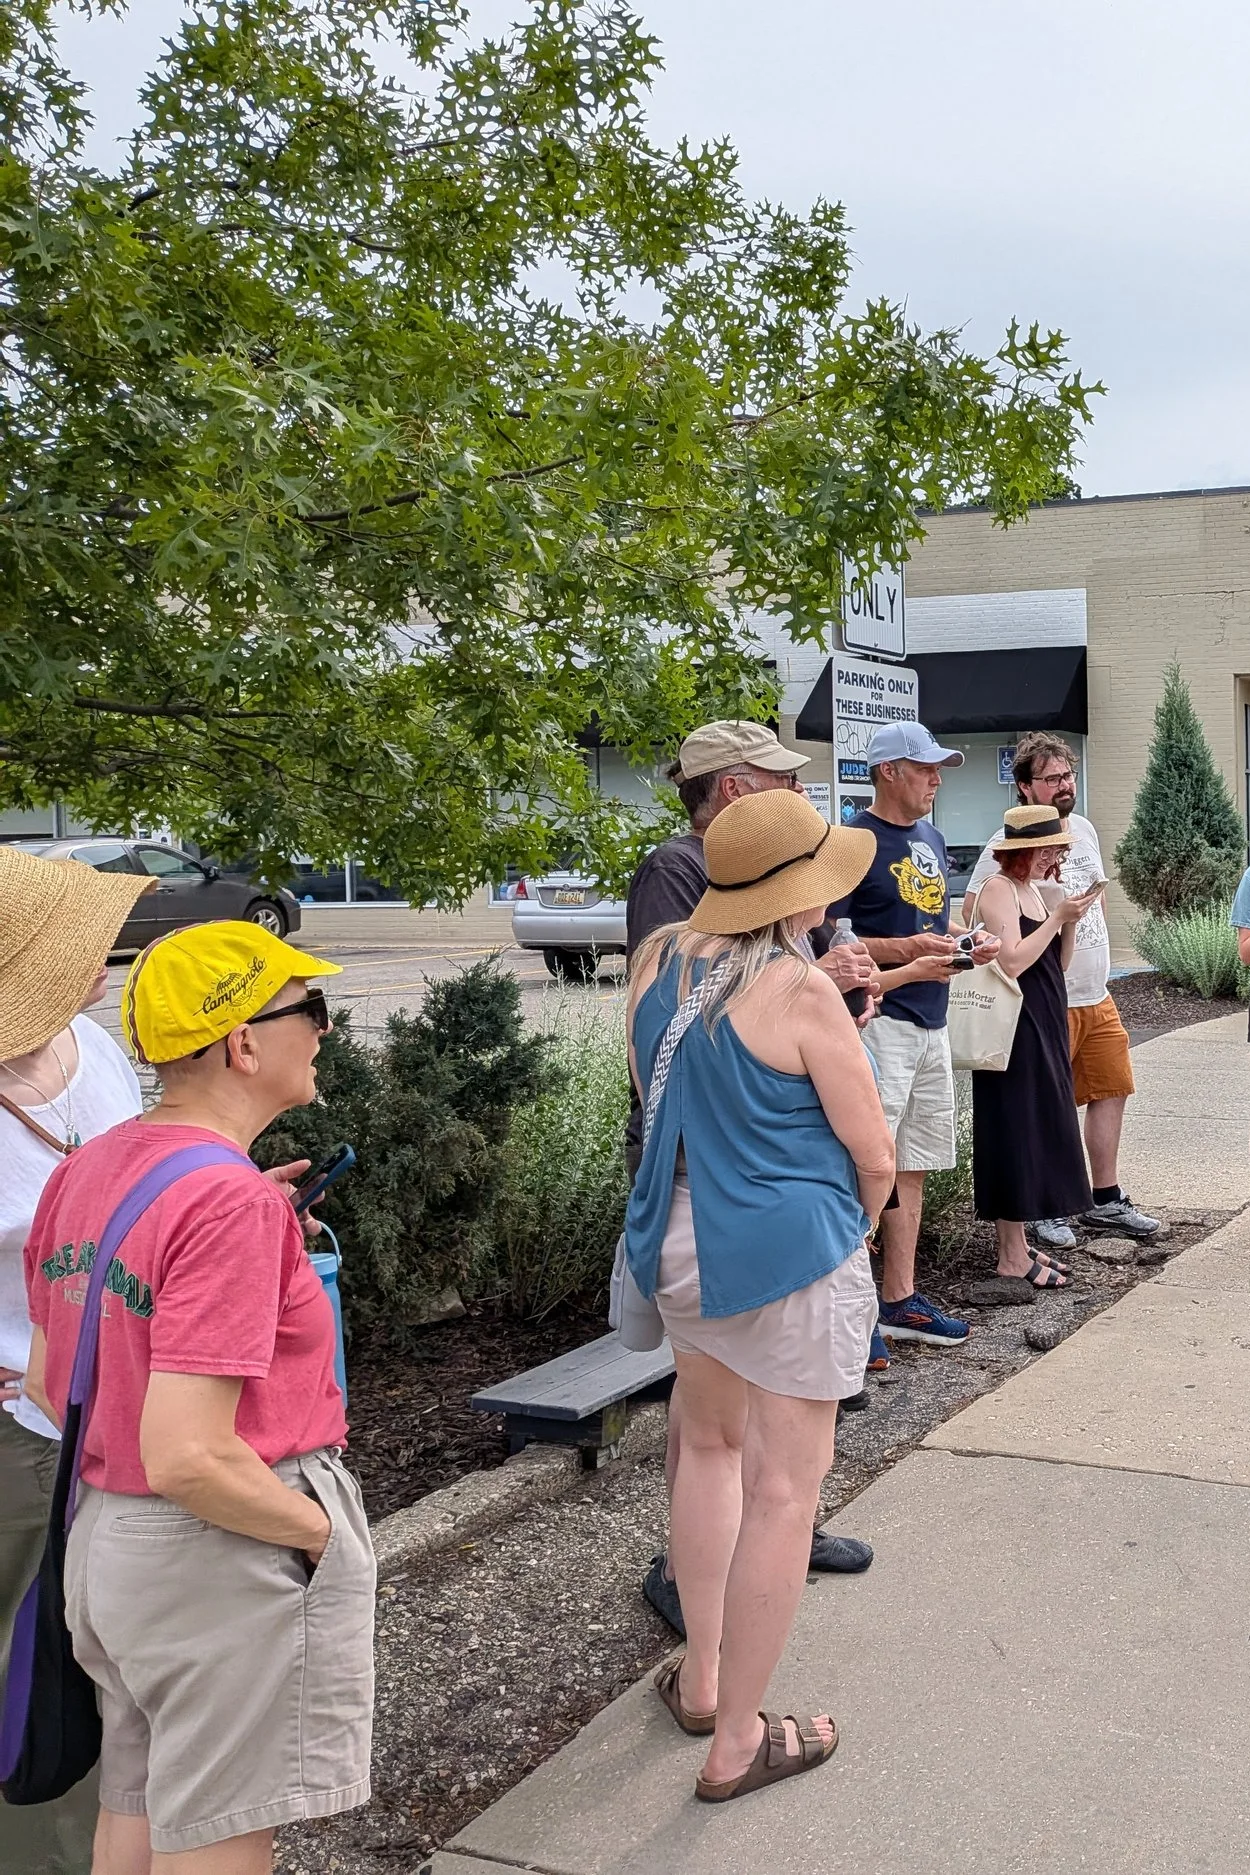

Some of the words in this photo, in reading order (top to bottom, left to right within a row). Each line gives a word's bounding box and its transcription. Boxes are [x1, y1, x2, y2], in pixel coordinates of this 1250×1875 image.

[850, 576, 897, 624] ONLY
[837, 669, 885, 691] PARKING
[887, 675, 914, 696] ONLY
[870, 691, 884, 702] FOR
[835, 698, 864, 716] THESE
[865, 702, 916, 722] BUSINESSES
[916, 854, 934, 874] M
[201, 956, 267, 1015] Campagnolo
[949, 989, 963, 999] ooks
[967, 990, 997, 1003] Mortar
